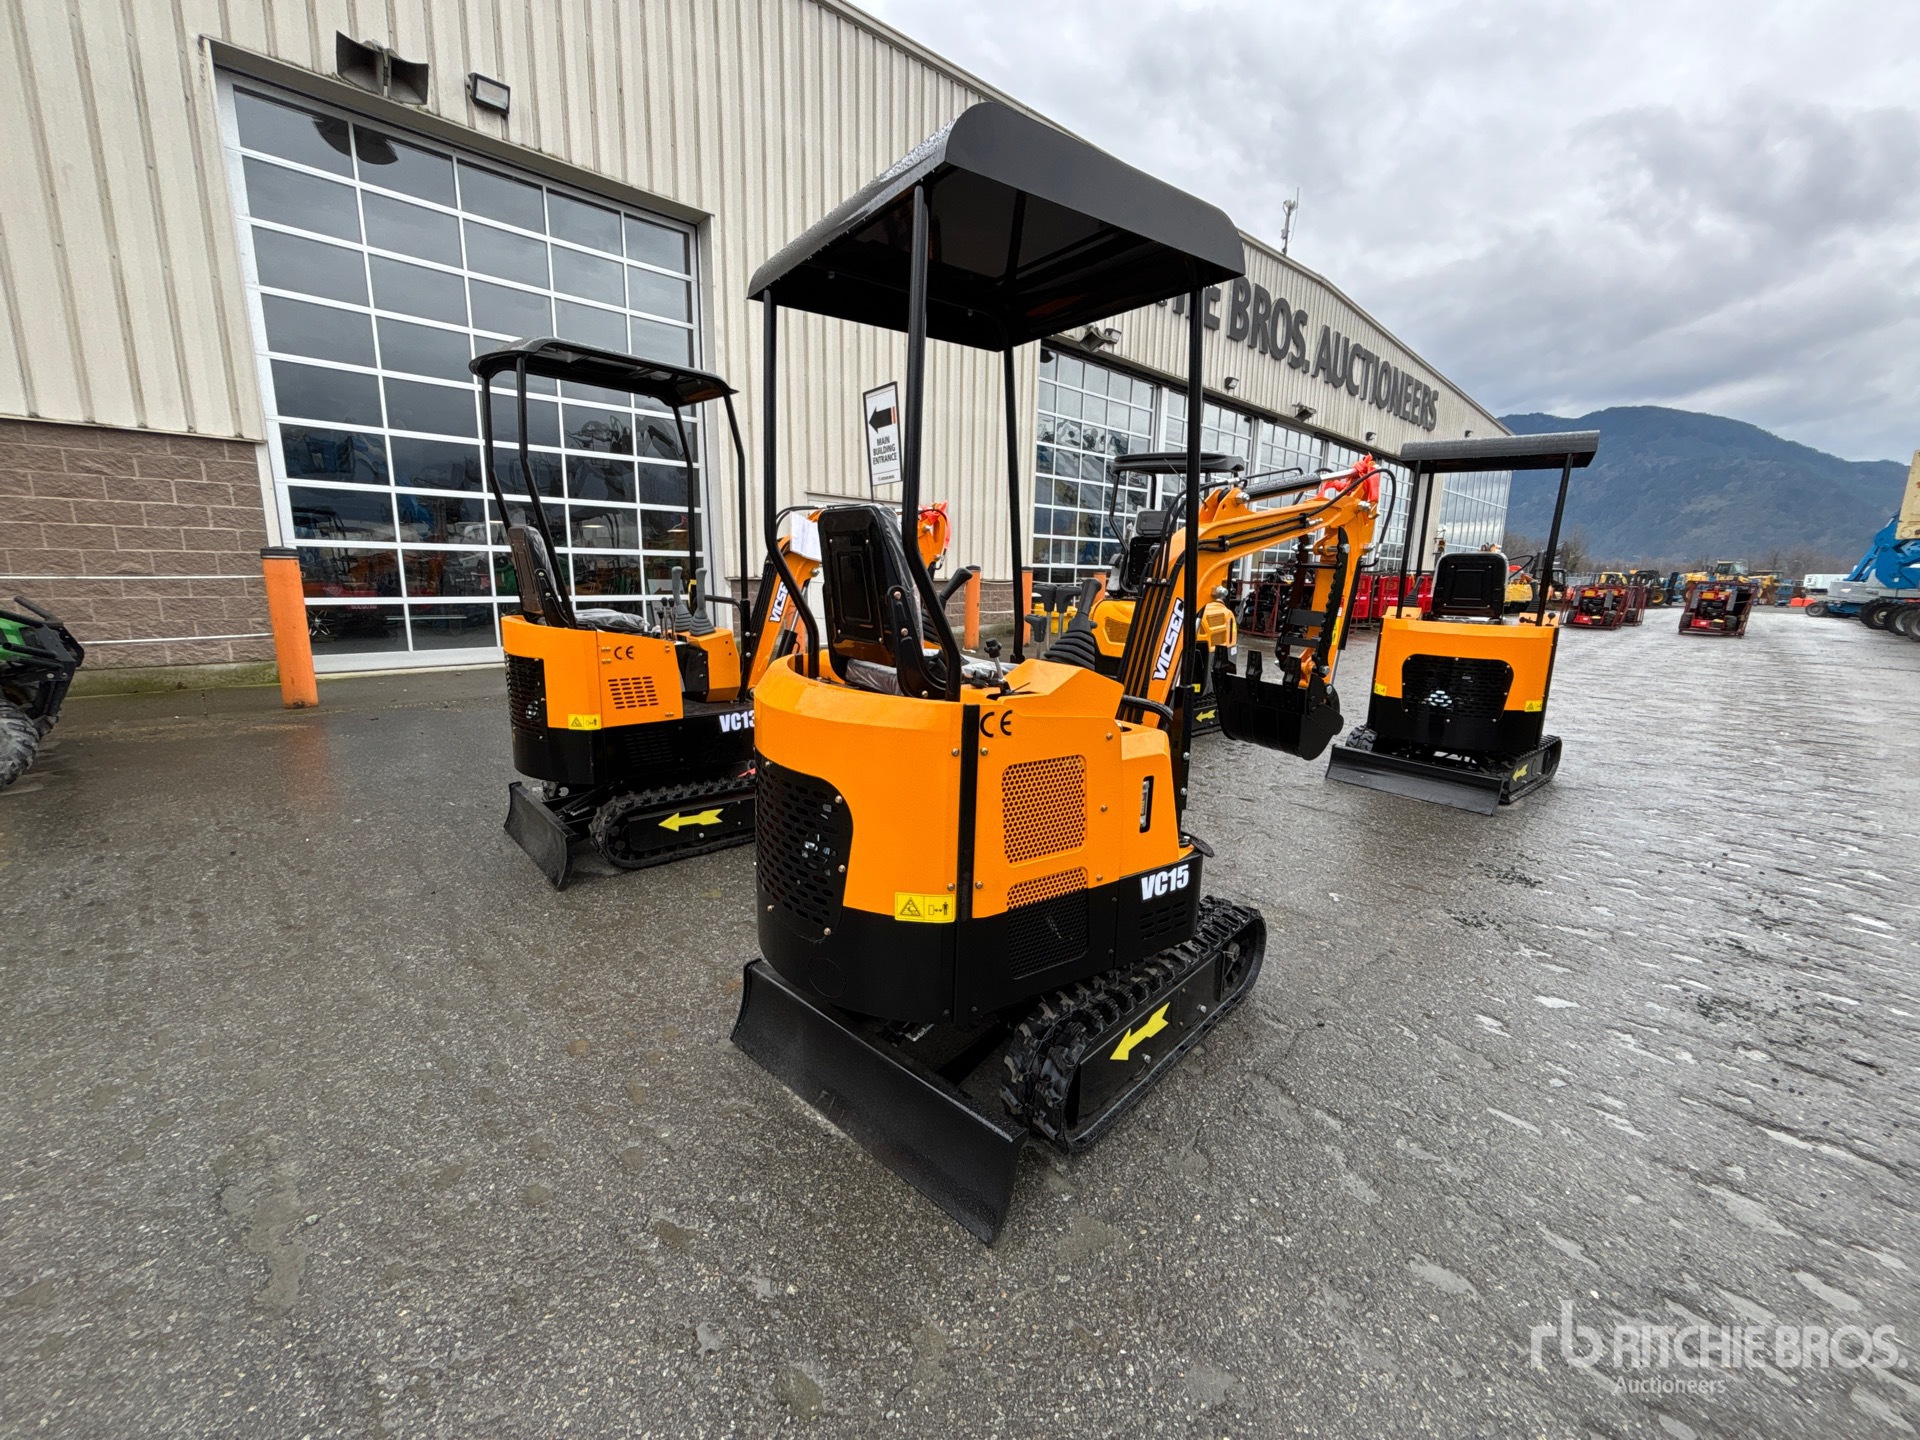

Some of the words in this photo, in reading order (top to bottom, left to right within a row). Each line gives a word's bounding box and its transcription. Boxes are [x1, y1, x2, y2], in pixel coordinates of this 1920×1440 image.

[1227, 276, 1309, 373] BROS.
[1311, 324, 1438, 431] AUCTIONEERS
[877, 436, 890, 446] MAIN
[873, 443, 895, 456] BUILDING
[873, 452, 897, 465] ENTRANCE
[614, 646, 634, 660] CE
[980, 710, 1012, 738] CE
[1141, 864, 1189, 900] VC15
